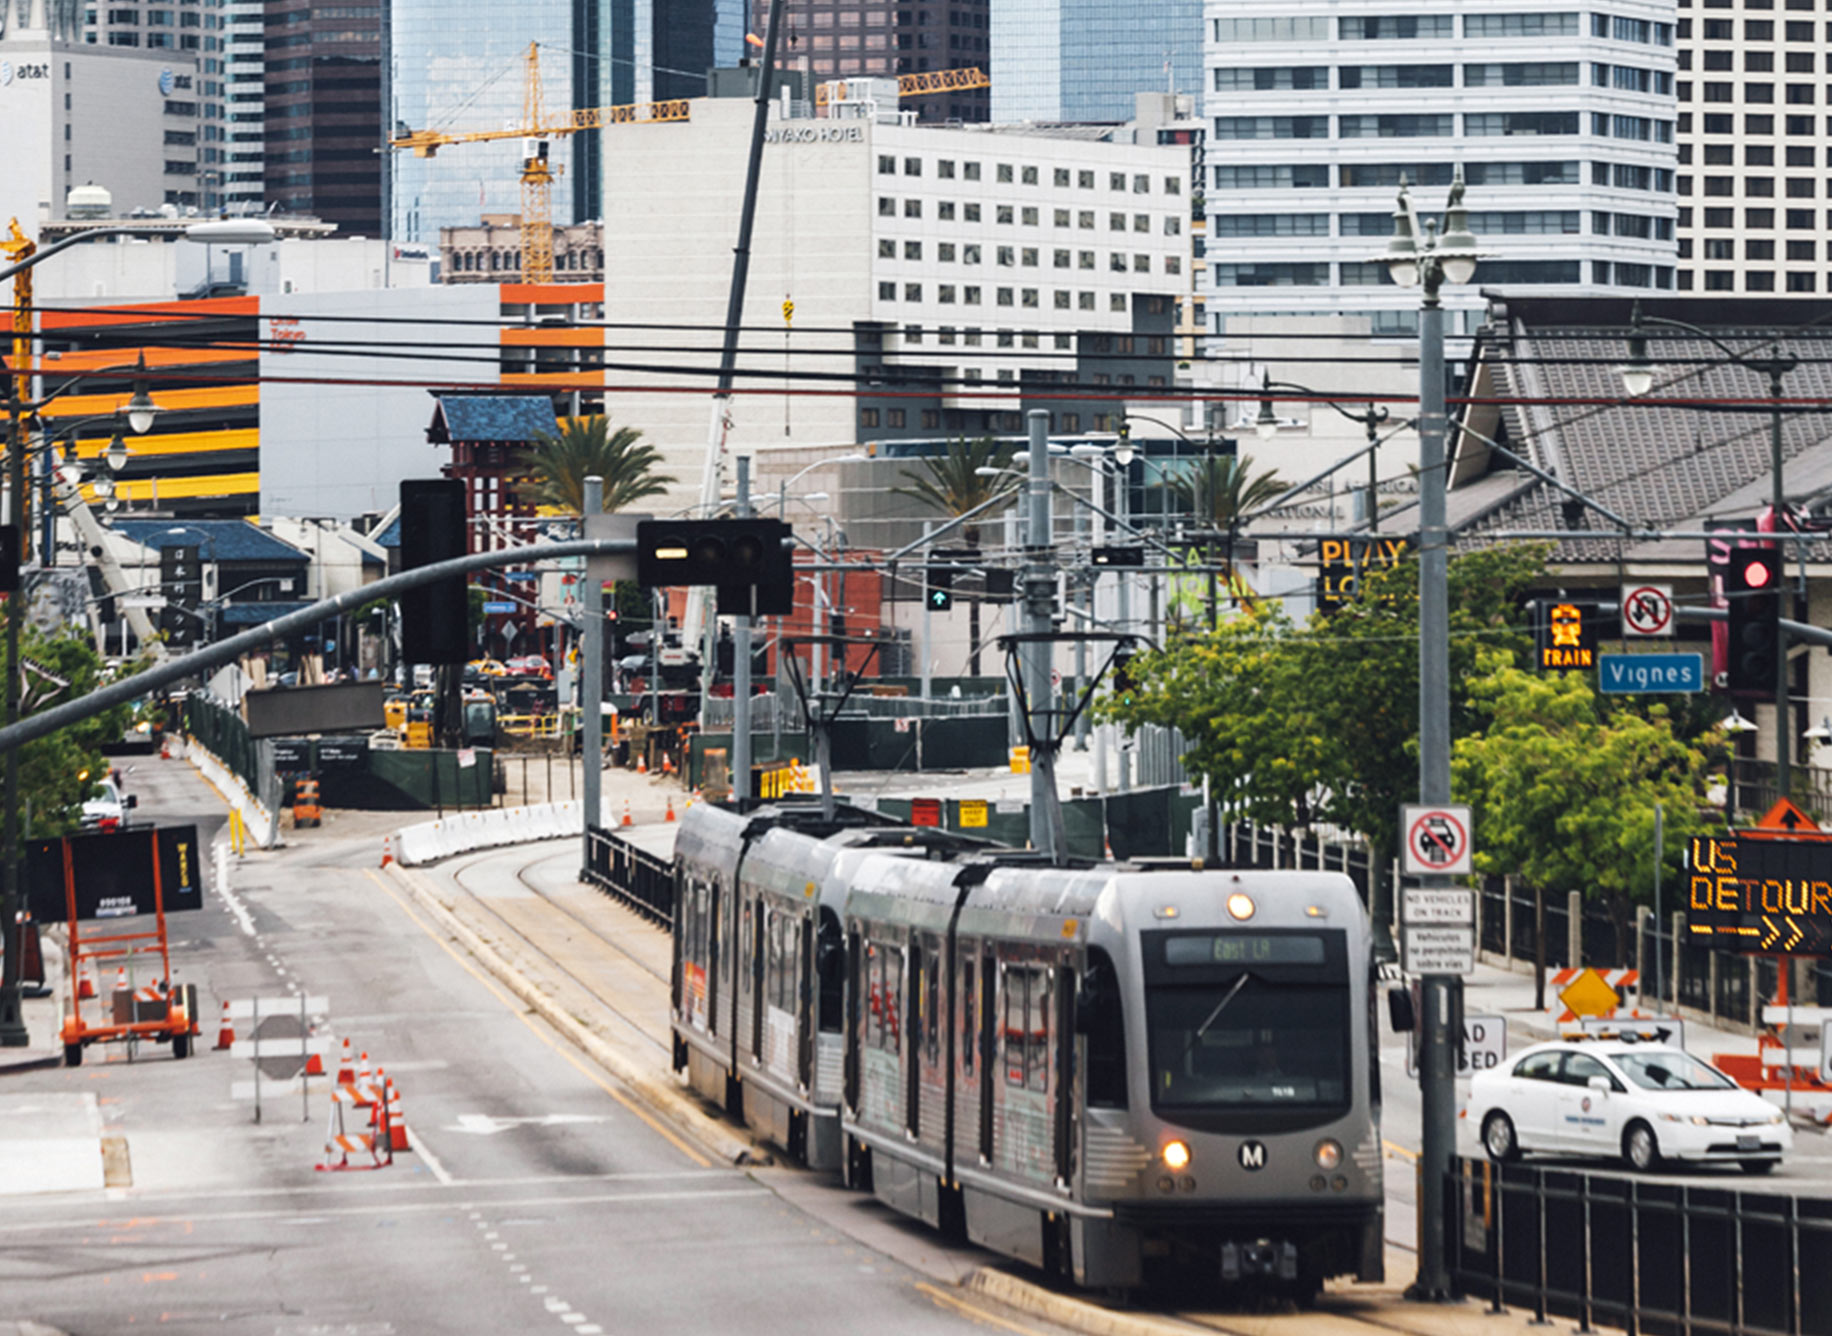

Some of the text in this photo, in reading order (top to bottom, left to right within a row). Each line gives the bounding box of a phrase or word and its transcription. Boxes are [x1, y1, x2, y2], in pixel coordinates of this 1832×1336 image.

[820, 127, 864, 142] HOTEL
[1322, 540, 1406, 568] PLAY
[1543, 648, 1592, 667] TRAIN
[1610, 662, 1692, 689] Vignes
[1693, 838, 1737, 875] US
[1406, 895, 1469, 904] NO VEHICLES
[1691, 876, 1832, 915] DETOUR
[1414, 908, 1461, 917] ON TRACK
[1242, 1144, 1263, 1167] M
